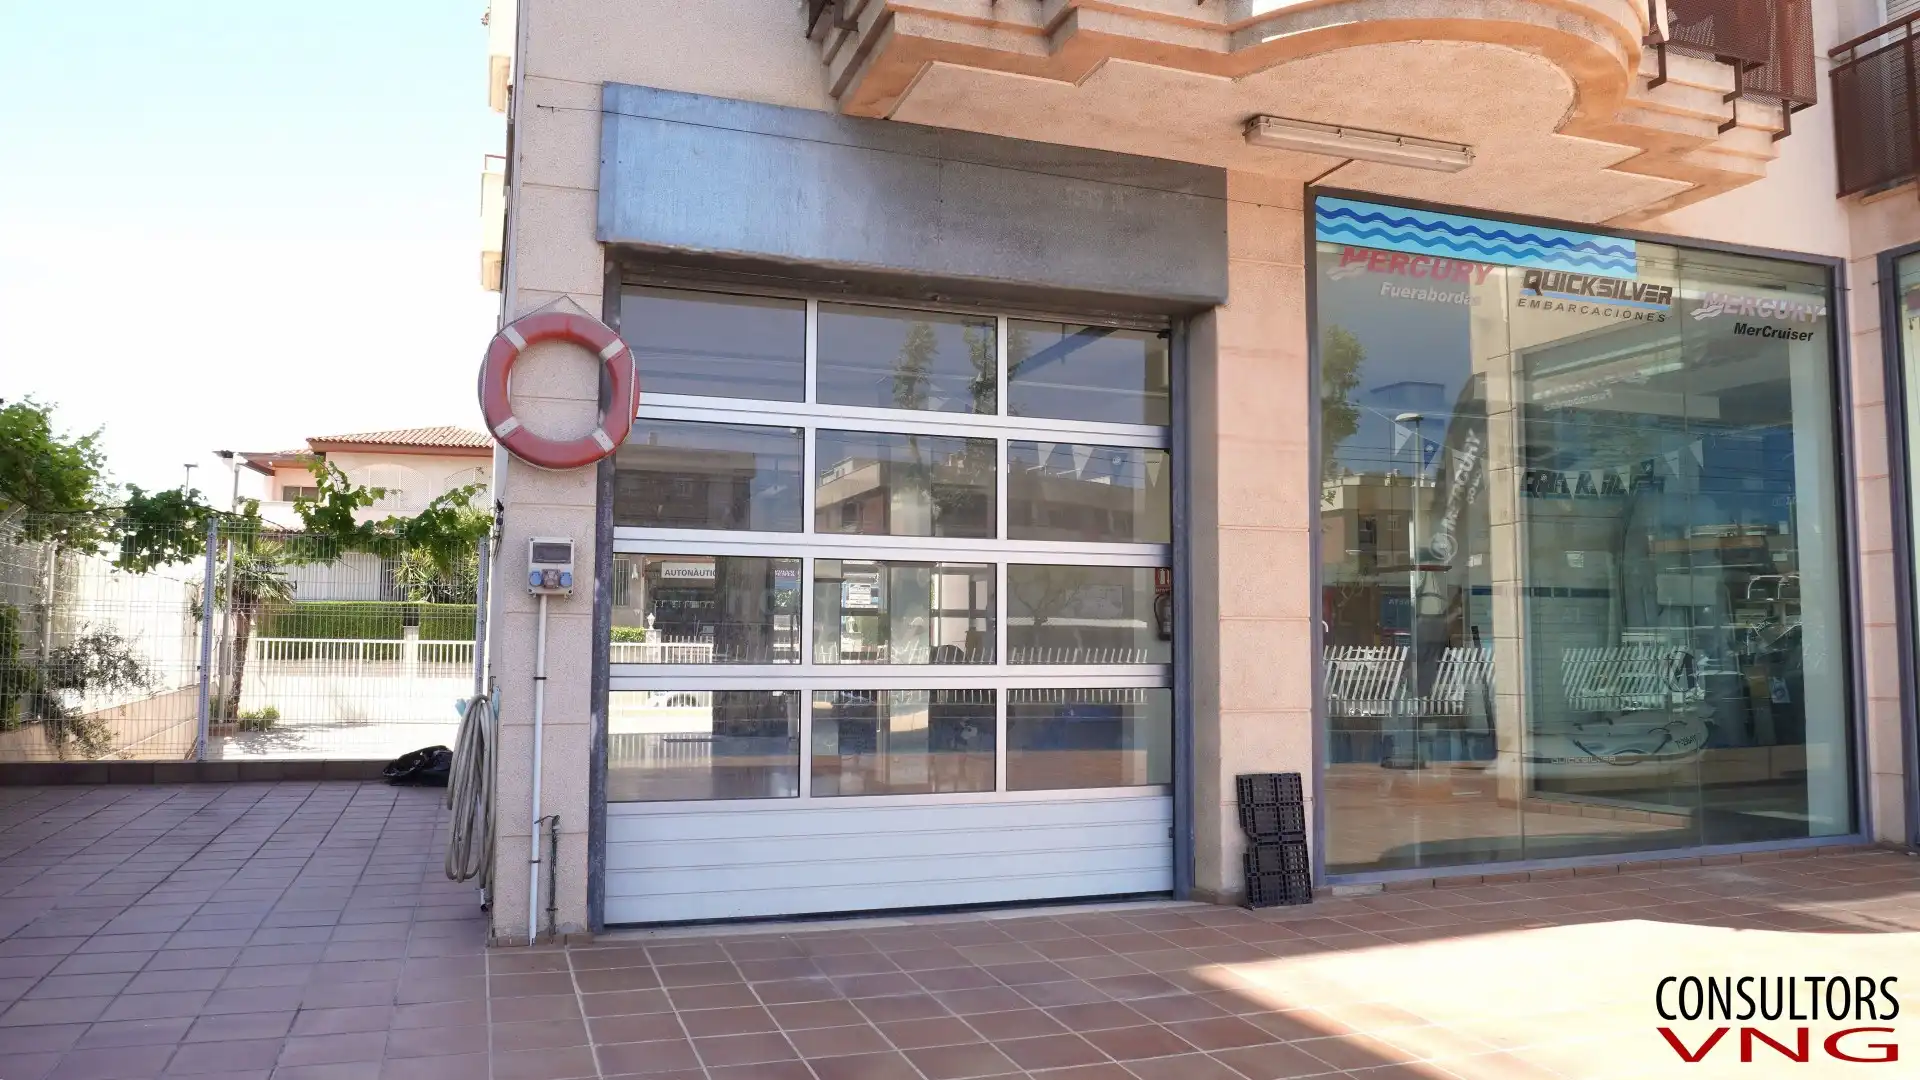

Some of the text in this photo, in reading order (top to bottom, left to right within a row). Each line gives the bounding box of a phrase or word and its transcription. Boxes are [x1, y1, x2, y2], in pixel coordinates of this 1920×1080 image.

[1340, 246, 1494, 286] MERCURY
[1380, 281, 1481, 306] Fuerabordas
[1523, 269, 1673, 305] QUICKSILVER
[1702, 291, 1826, 323] MERCURY
[1734, 322, 1814, 342] MerCruiser
